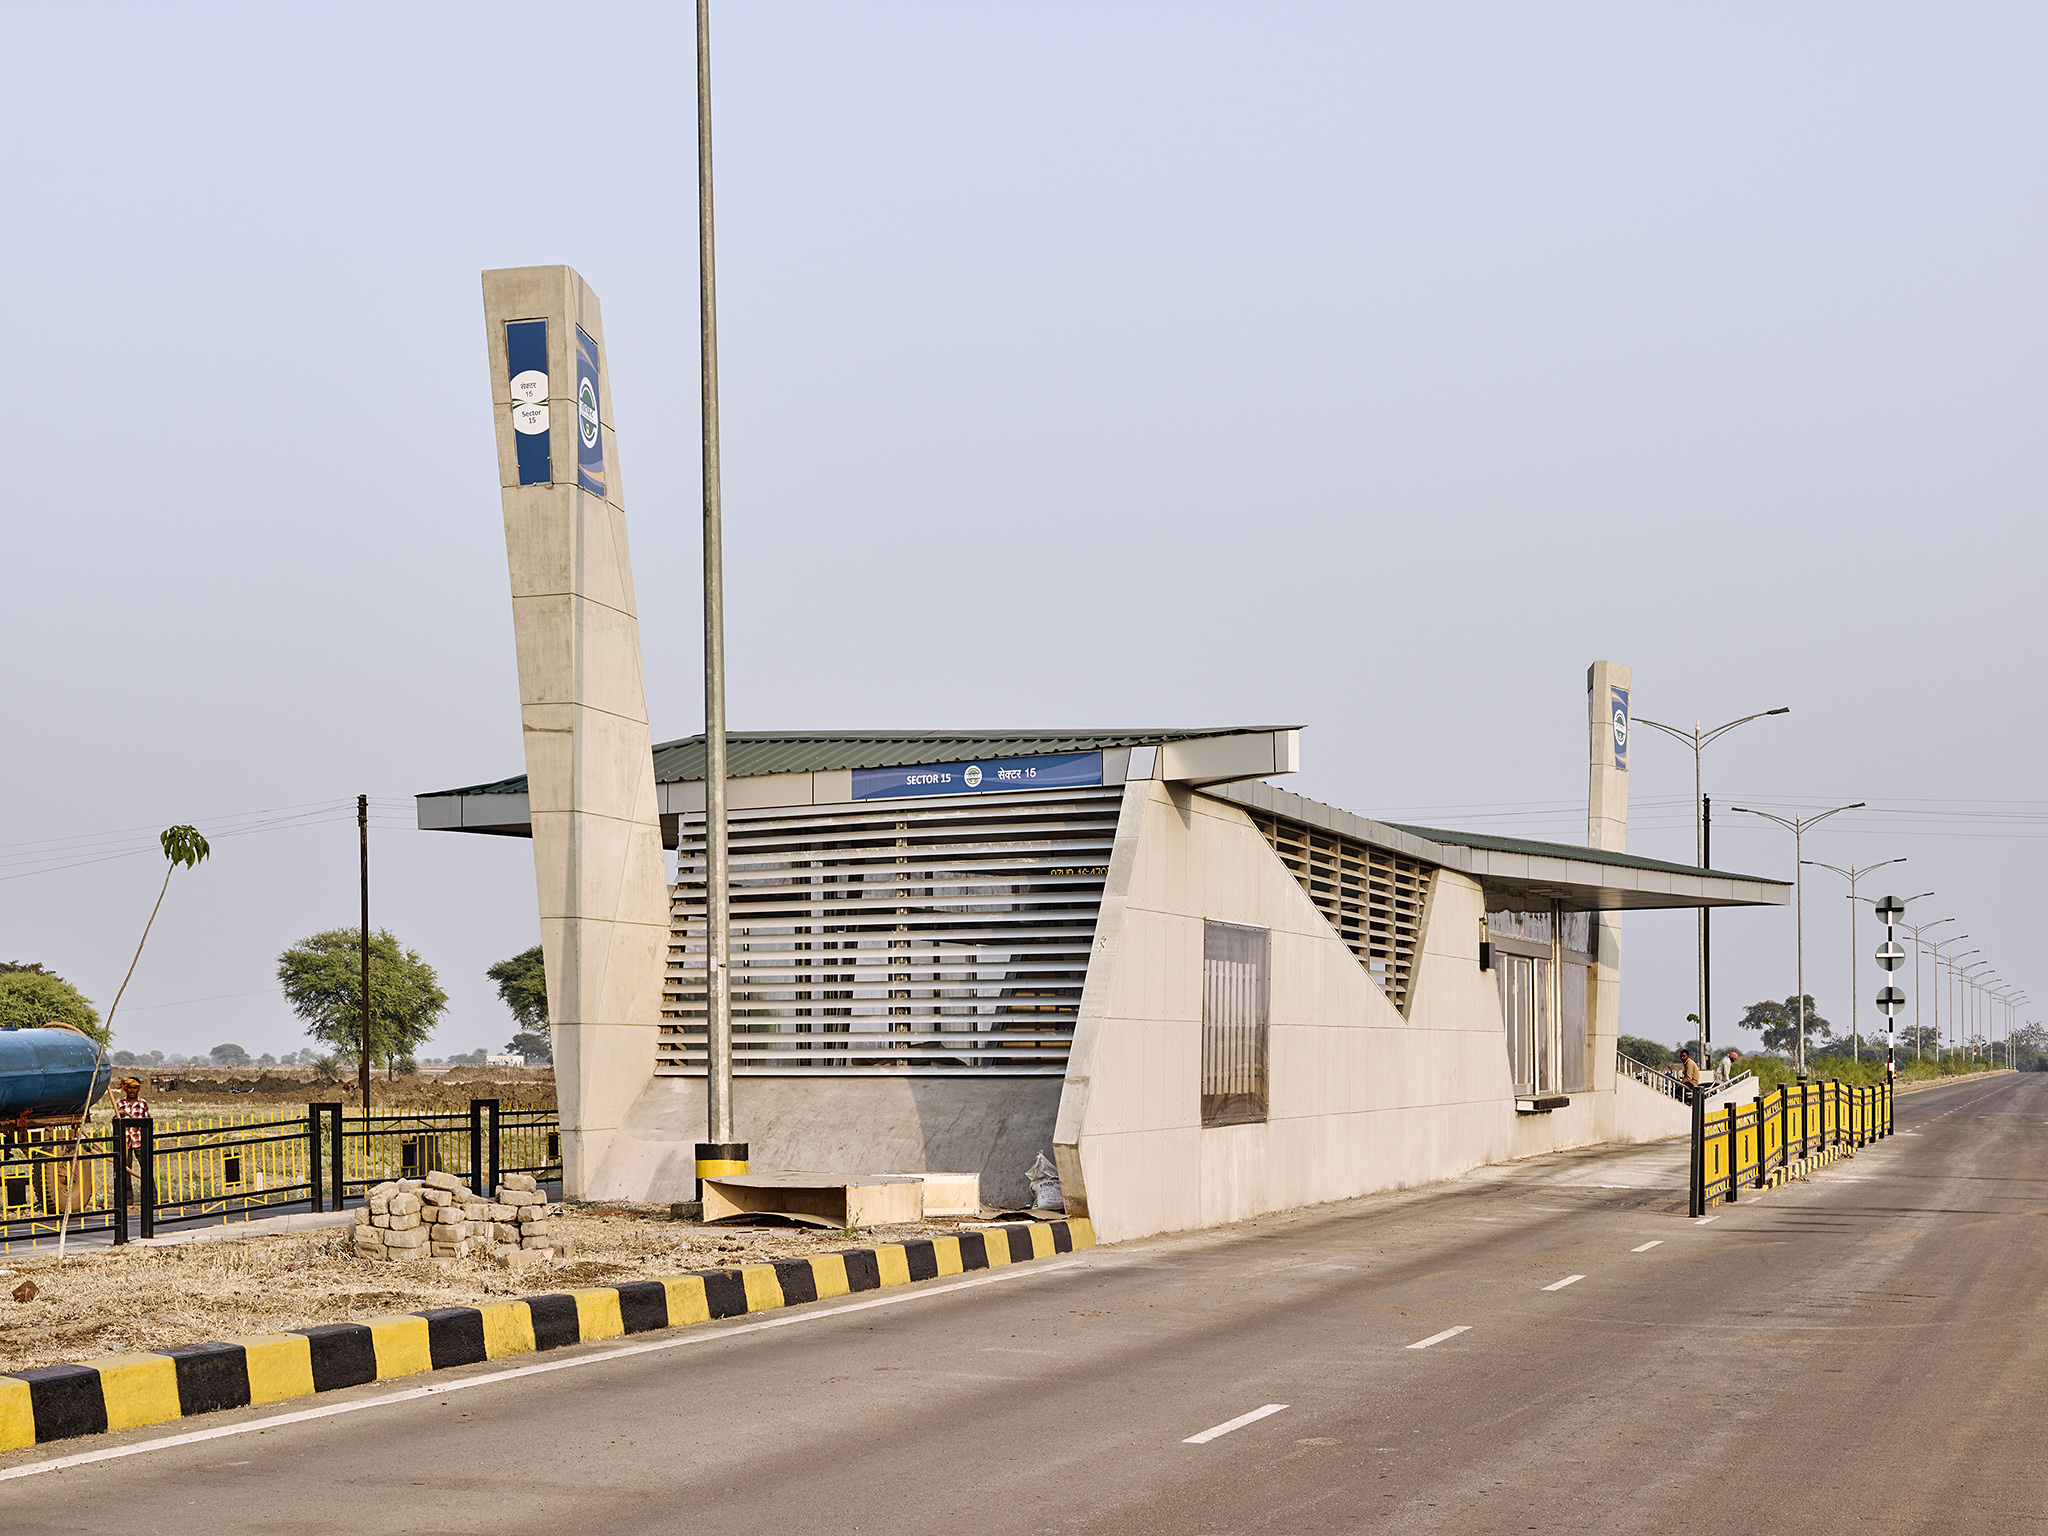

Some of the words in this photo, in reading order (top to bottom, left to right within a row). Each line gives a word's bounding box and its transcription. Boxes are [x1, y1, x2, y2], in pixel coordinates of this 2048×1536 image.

[520, 382, 536, 390] सेक्टर
[521, 410, 541, 418] Sector
[997, 766, 1021, 780] सेक्टर
[1025, 767, 1037, 778] 15
[906, 774, 939, 785] SECTOR
[940, 773, 951, 783] 15
